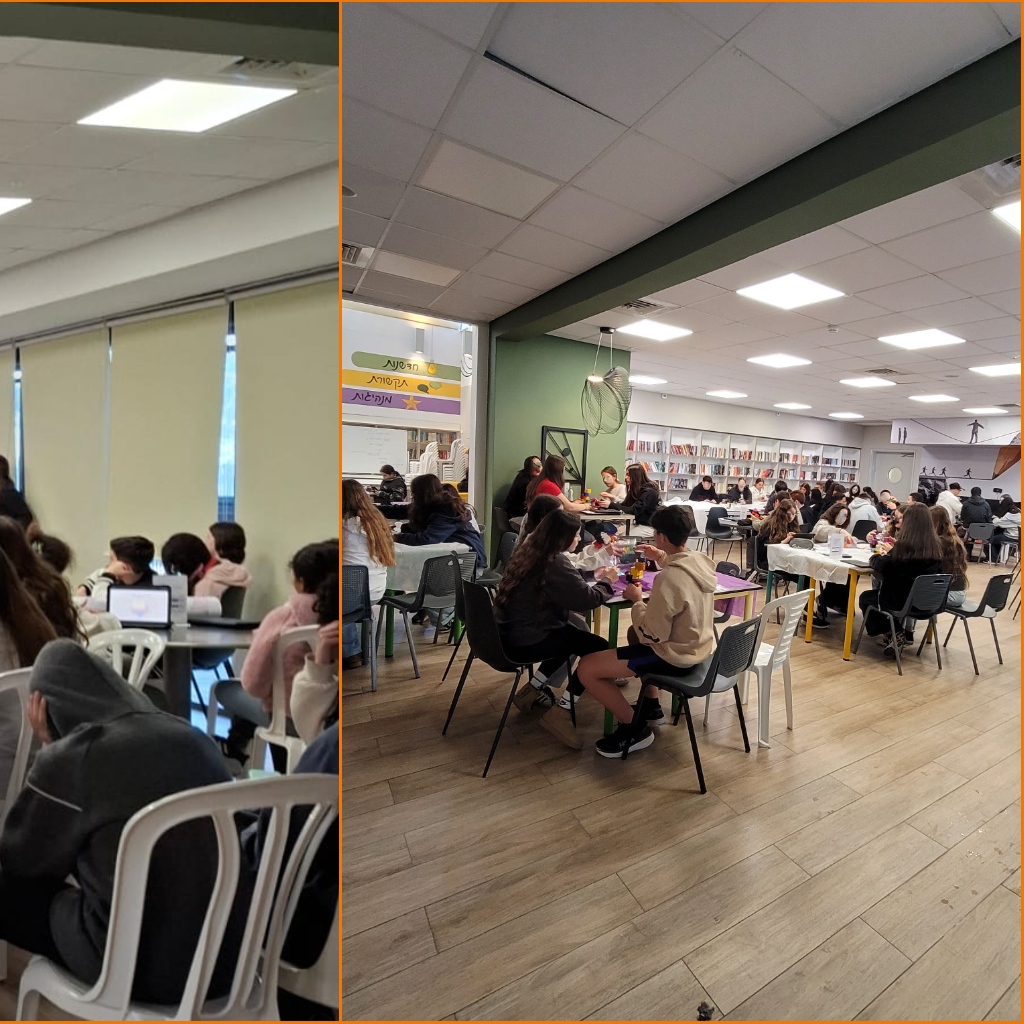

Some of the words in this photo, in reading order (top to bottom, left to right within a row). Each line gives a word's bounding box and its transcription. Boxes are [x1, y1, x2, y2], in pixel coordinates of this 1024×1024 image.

[382, 359, 419, 371] חדשנות
[366, 375, 409, 390] תקשורת
[350, 391, 393, 406] מנהיגות
